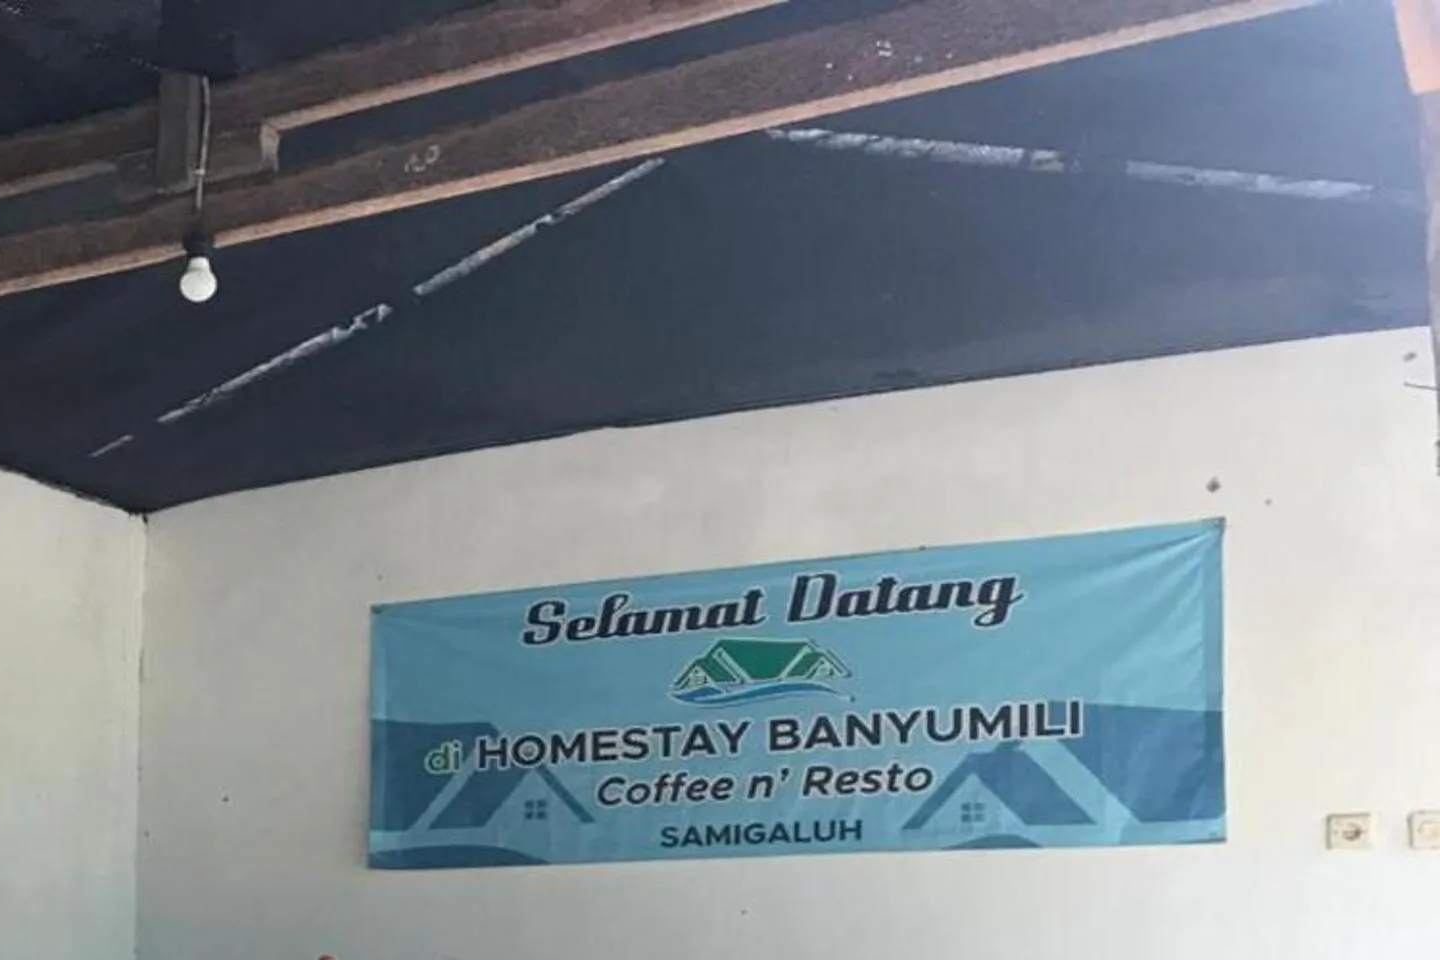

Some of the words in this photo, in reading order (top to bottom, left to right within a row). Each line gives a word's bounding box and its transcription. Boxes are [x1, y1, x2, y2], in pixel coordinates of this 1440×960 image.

[522, 588, 766, 646] Selamat
[787, 573, 1023, 627] Datang
[425, 740, 461, 773] di
[477, 720, 751, 769] HOMESTAY
[768, 700, 1081, 751] BANYUMILI
[597, 772, 734, 806] Coffee
[802, 763, 934, 796] Resto
[660, 820, 863, 848] SAMIGALUH
